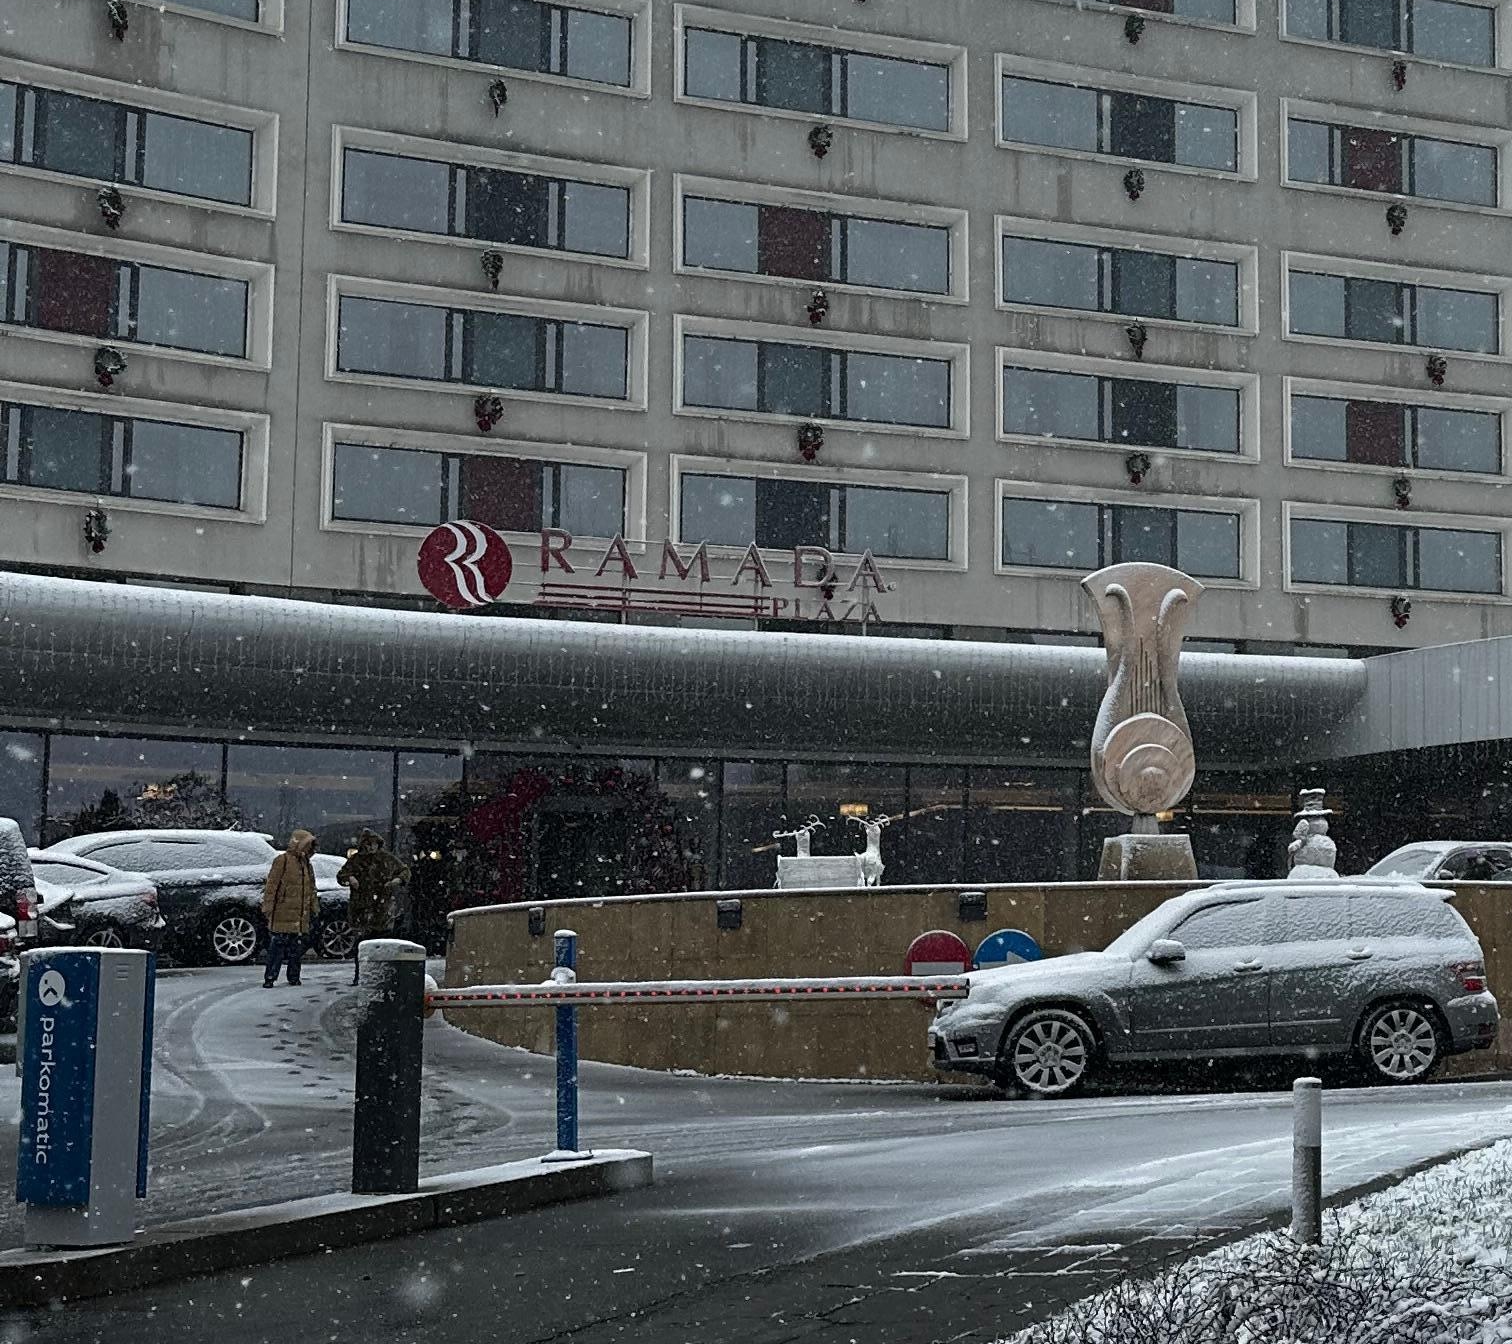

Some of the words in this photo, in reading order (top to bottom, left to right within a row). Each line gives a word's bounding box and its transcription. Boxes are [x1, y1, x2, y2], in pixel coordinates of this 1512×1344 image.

[539, 527, 887, 594] RAMADA
[772, 596, 882, 623] PLAZA
[35, 1016, 57, 1165] parkomatic
